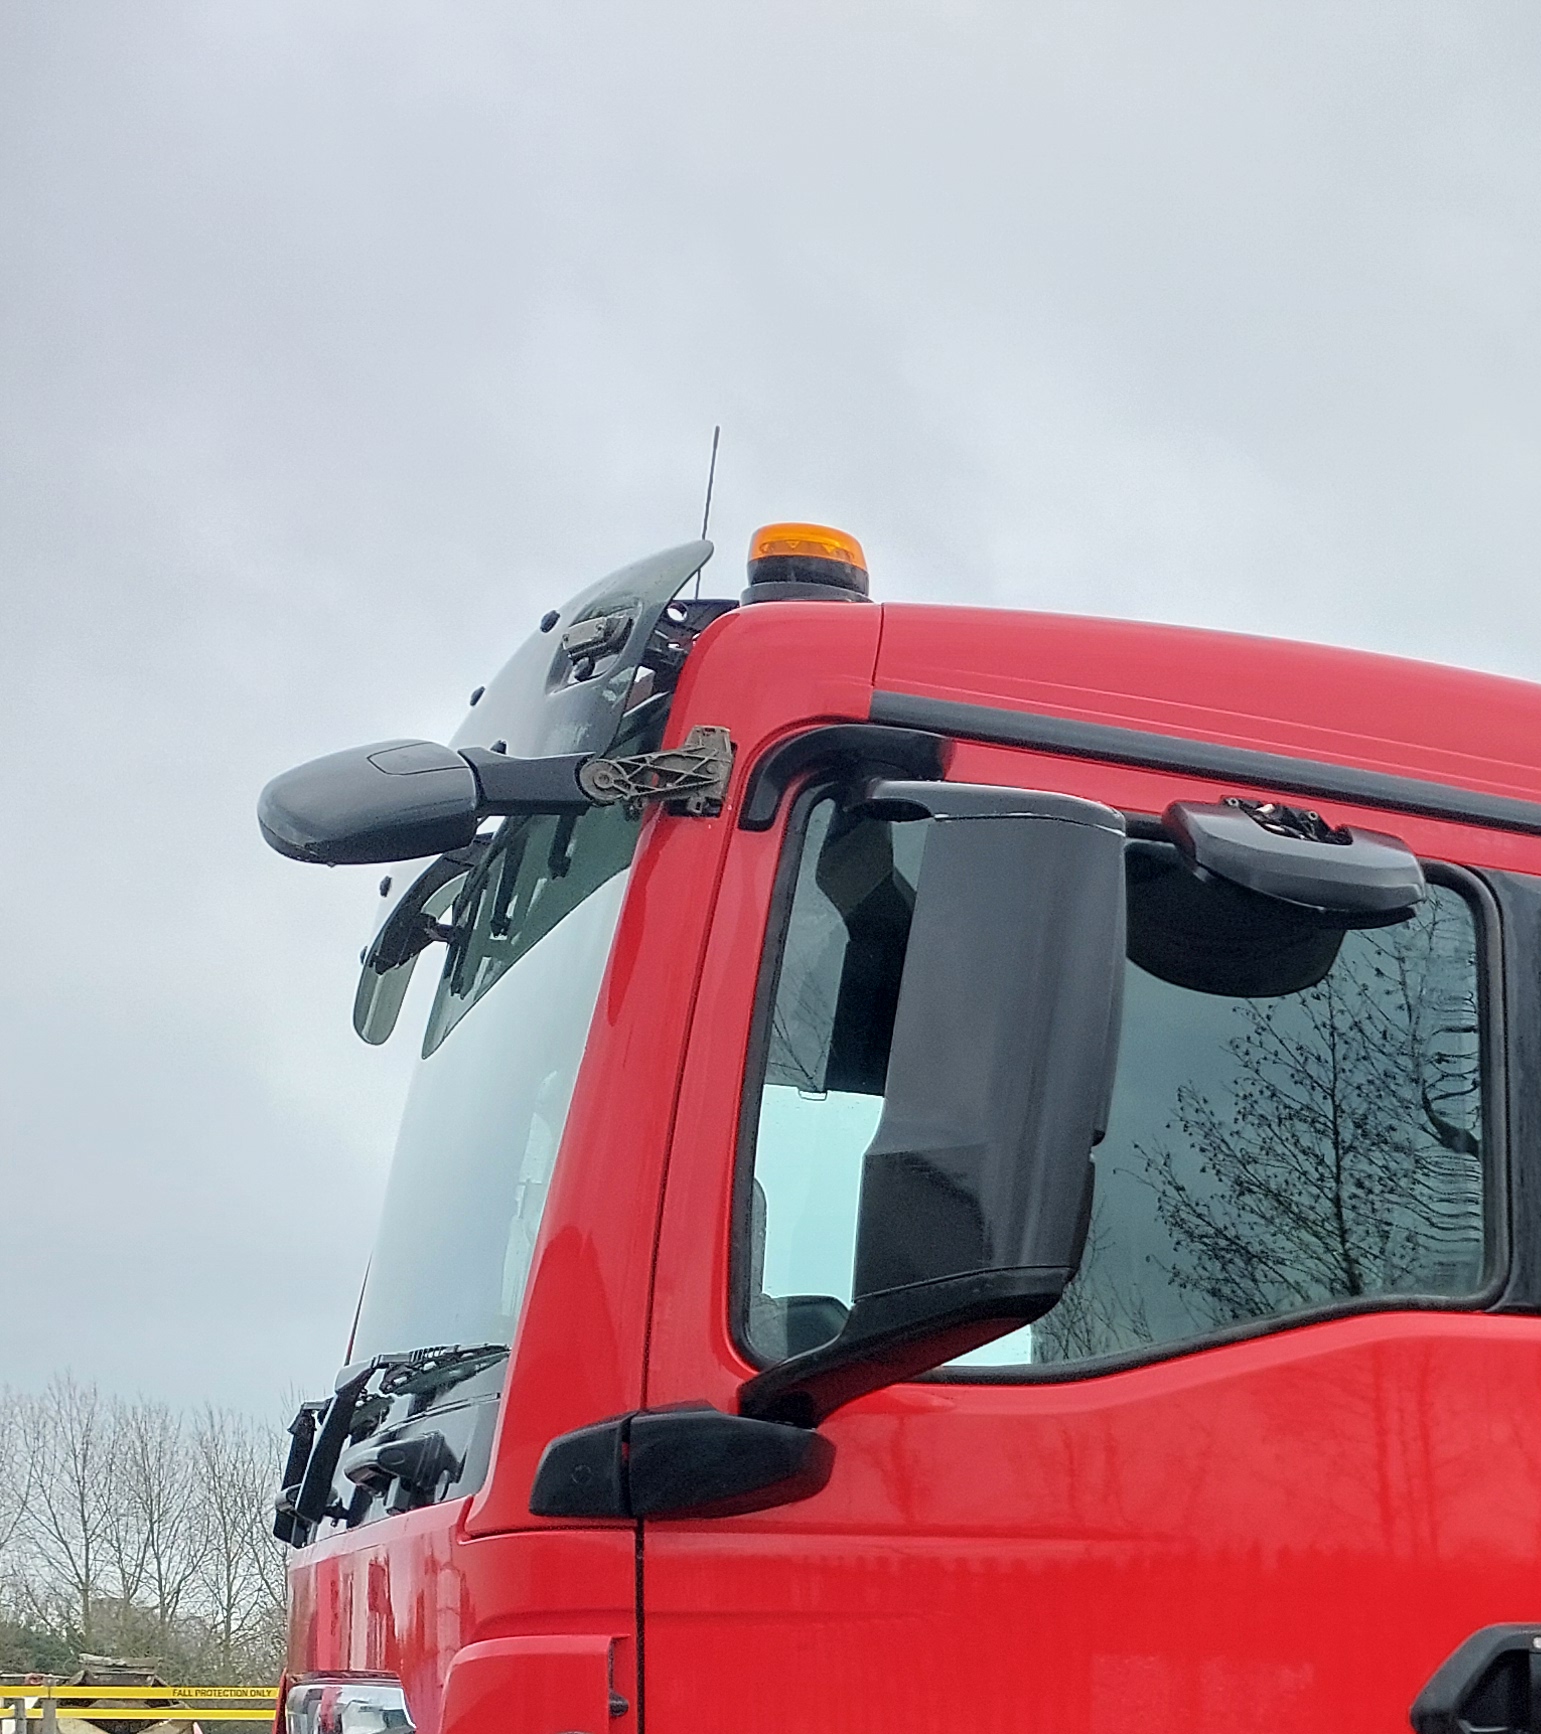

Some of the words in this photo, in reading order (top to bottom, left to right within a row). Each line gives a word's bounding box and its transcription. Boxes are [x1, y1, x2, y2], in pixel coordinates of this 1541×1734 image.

[172, 1689, 194, 1698] FALL
[195, 1689, 248, 1698] PROTECTION
[250, 1689, 272, 1698] ONLY
